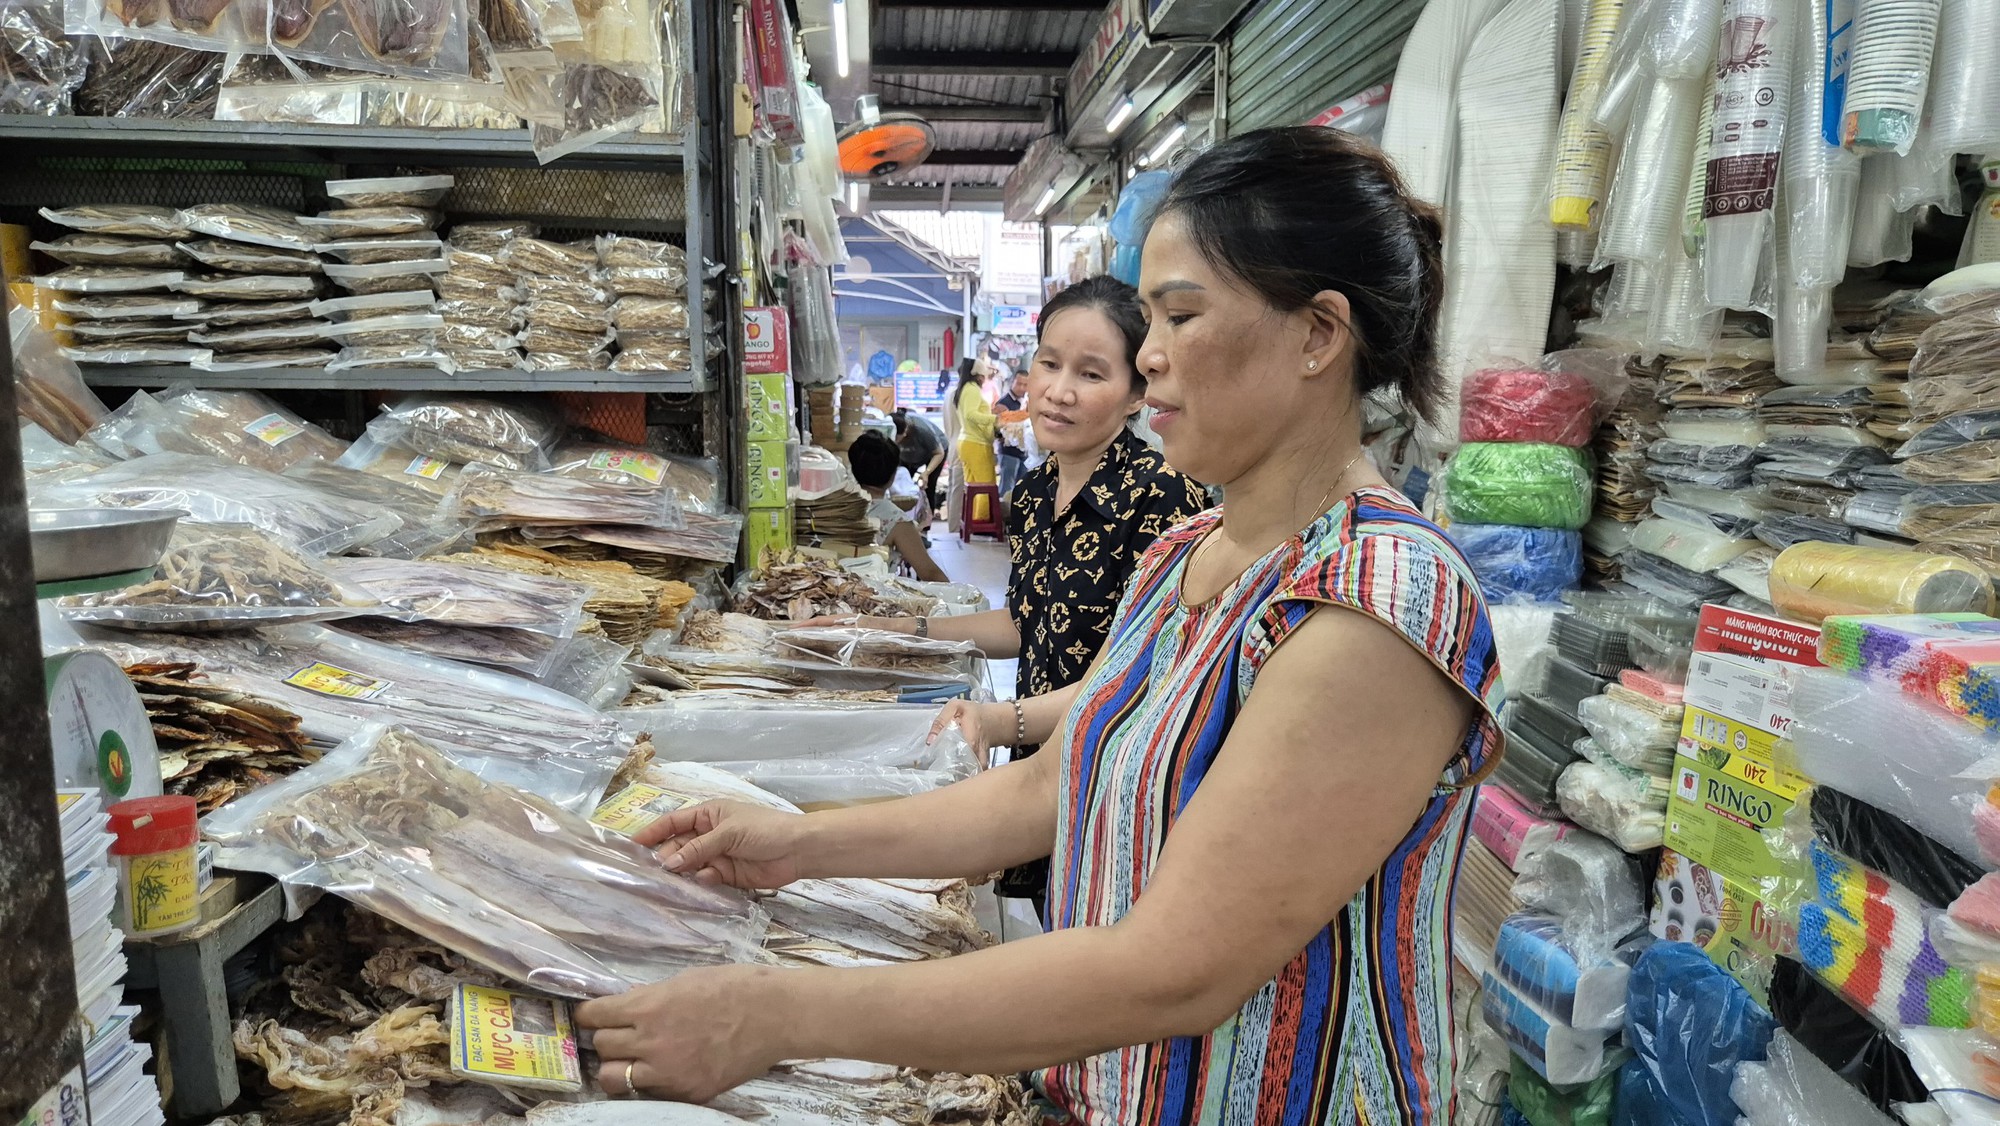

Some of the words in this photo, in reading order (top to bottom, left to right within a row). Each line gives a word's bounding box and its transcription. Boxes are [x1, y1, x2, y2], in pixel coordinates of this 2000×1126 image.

[763, 9, 776, 47] RINGO
[749, 380, 765, 434] RINGO
[749, 446, 764, 500] RINGO
[1725, 615, 1746, 630] MÀNG
[1745, 622, 1768, 635] NHÔM
[1767, 627, 1783, 640] BỌC
[1769, 713, 1791, 732] 240
[1744, 763, 1767, 784] 240
[1708, 778, 1772, 823] RINGO
[484, 995, 511, 1028] CÂU
[491, 1032, 520, 1071] MỰC
